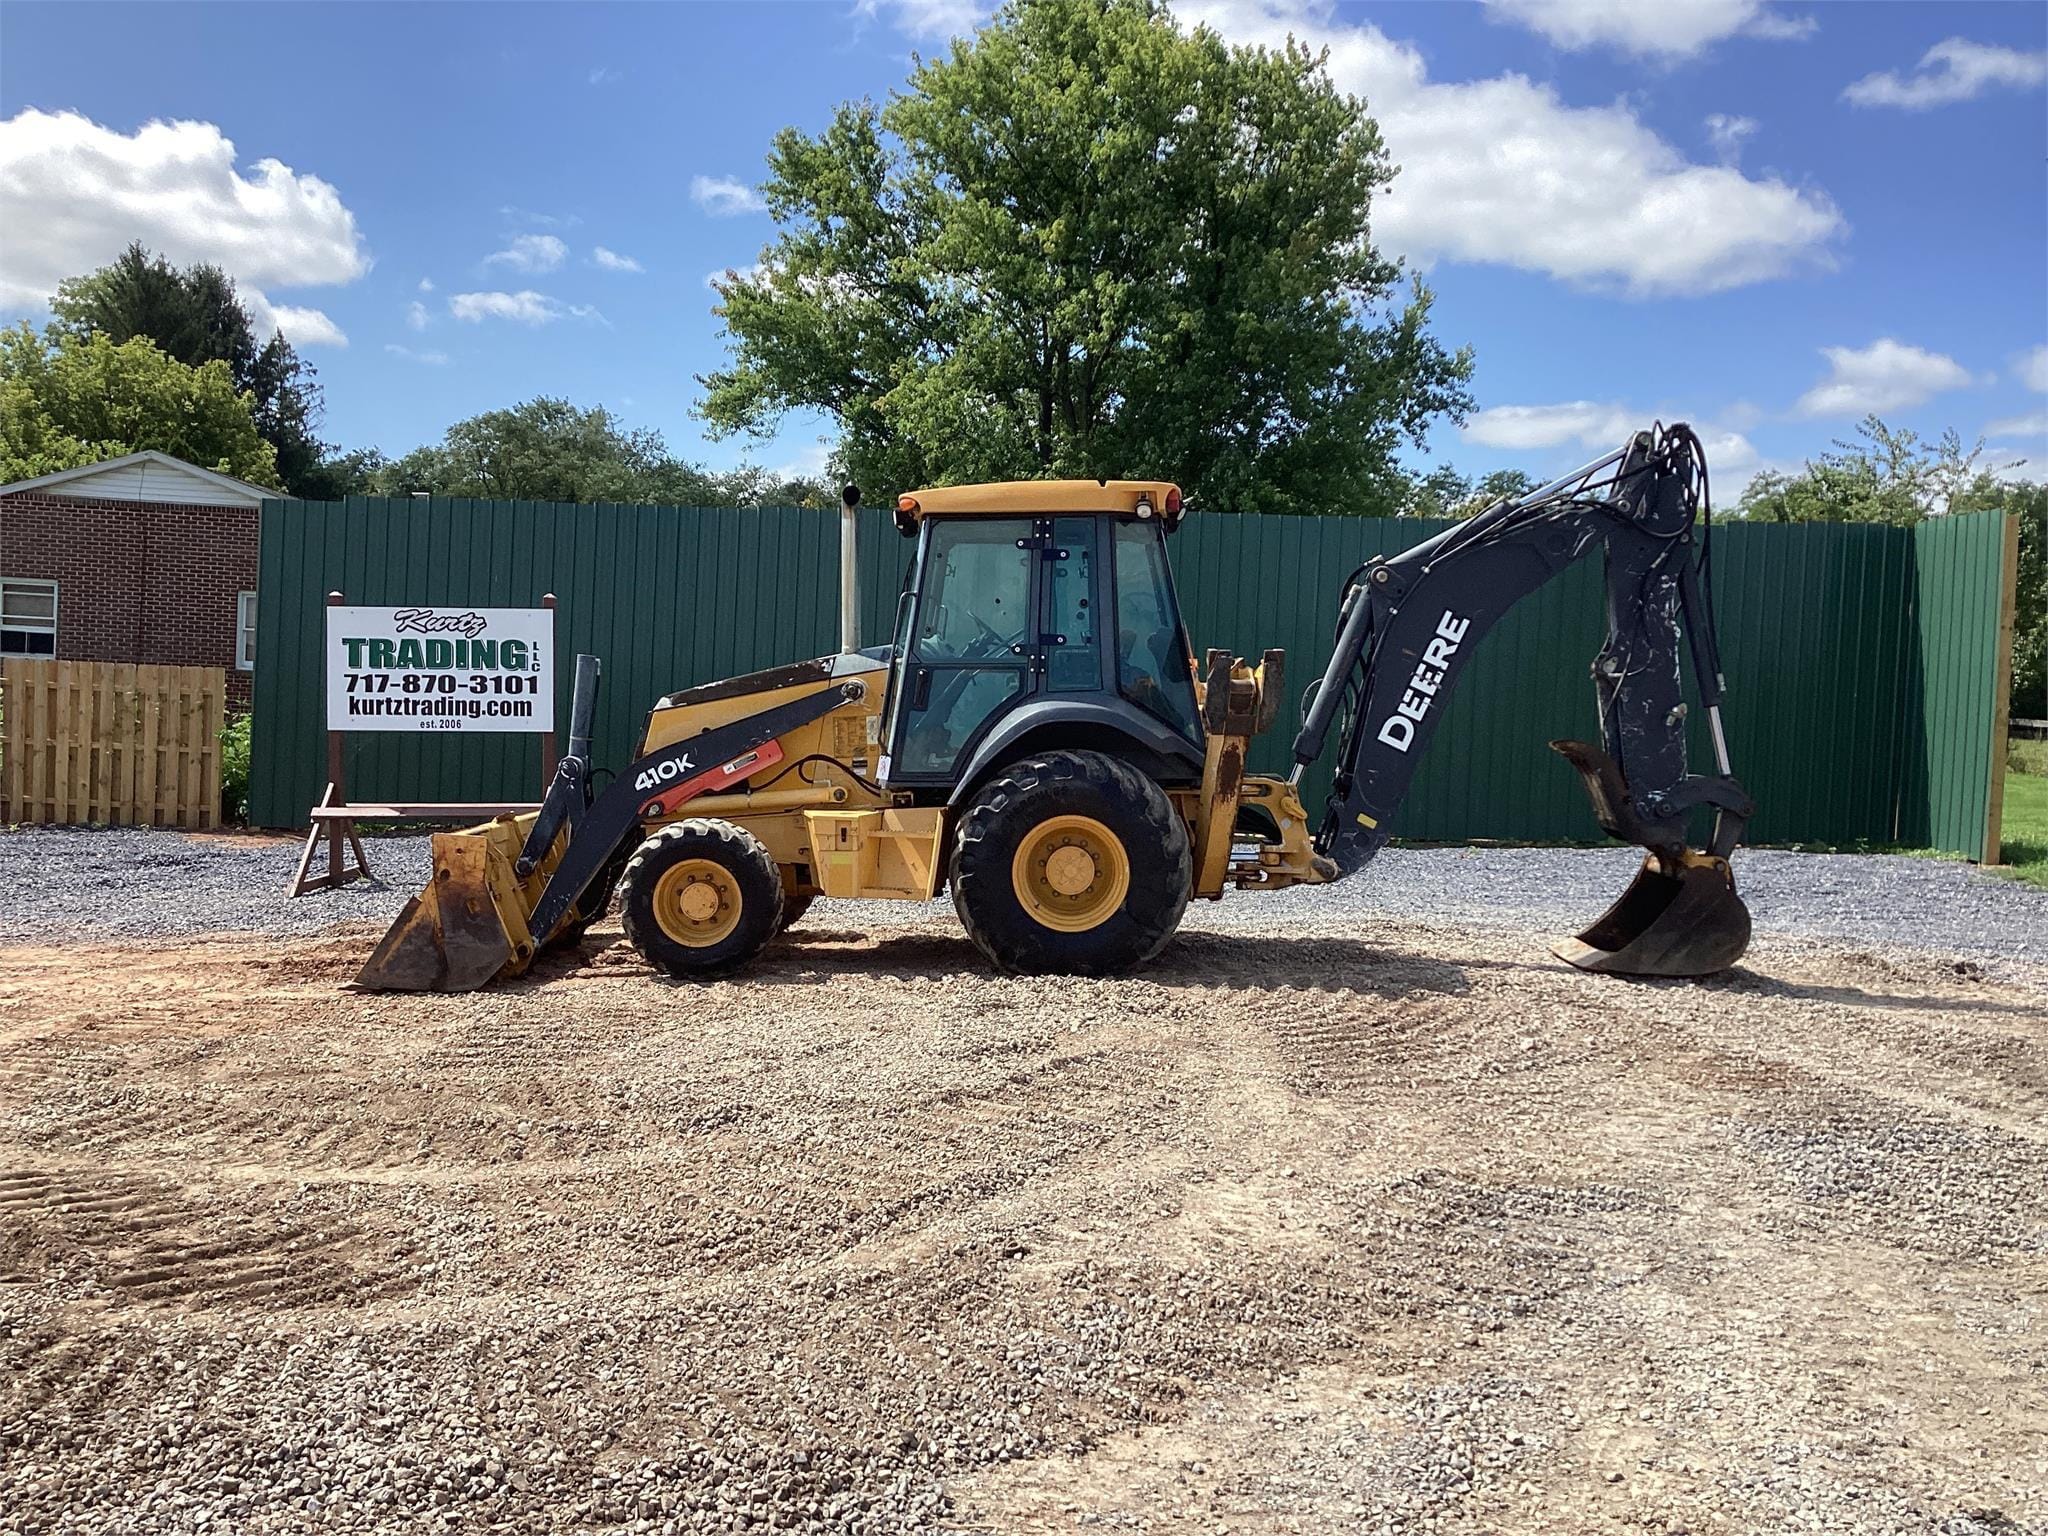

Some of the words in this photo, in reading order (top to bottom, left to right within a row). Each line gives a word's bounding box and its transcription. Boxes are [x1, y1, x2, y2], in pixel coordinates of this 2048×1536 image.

[394, 608, 487, 639] Kurtz
[342, 638, 529, 671] TRADING
[531, 641, 541, 673] LLC
[343, 674, 538, 694] 717-870-3101
[1377, 610, 1471, 753] DEERE
[349, 696, 532, 719] kurtztrading.com
[420, 720, 437, 729] est.
[439, 719, 462, 729] 2006
[634, 752, 696, 792] 410K
